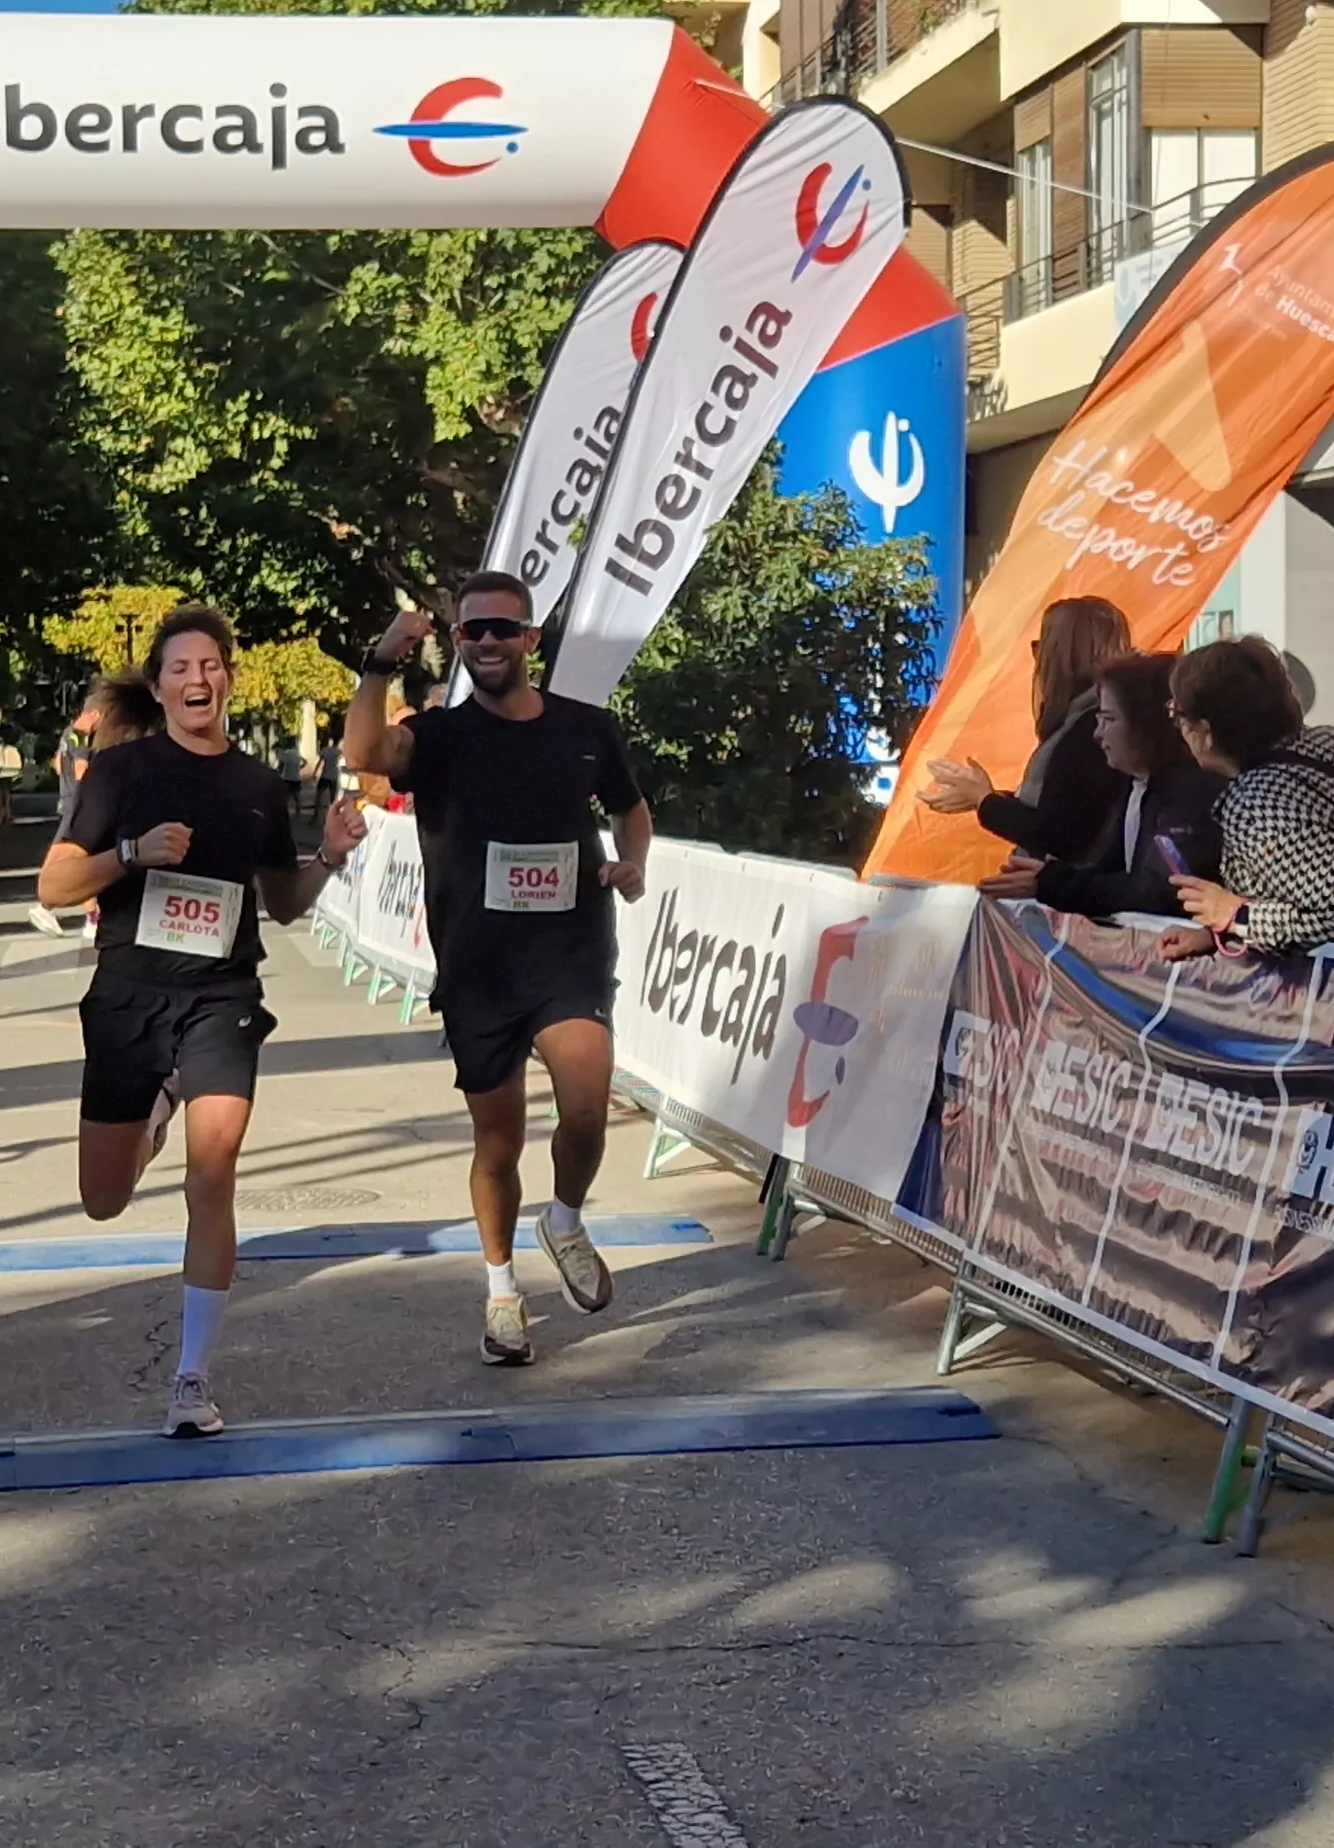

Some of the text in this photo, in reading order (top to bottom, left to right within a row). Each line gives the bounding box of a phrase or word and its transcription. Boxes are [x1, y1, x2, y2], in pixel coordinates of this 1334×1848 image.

[519, 405, 624, 588] ercaja
[604, 301, 793, 597] Ibercaja
[1048, 438, 1229, 553] Hacemos
[1037, 490, 1195, 587] deporte
[164, 895, 221, 924] 505
[508, 866, 560, 889] 504
[159, 919, 220, 937] CARLOTA
[639, 886, 787, 1086] Ibercaja
[1053, 1046, 1133, 1133] ESIC
[1168, 1078, 1264, 1176] ESIC
